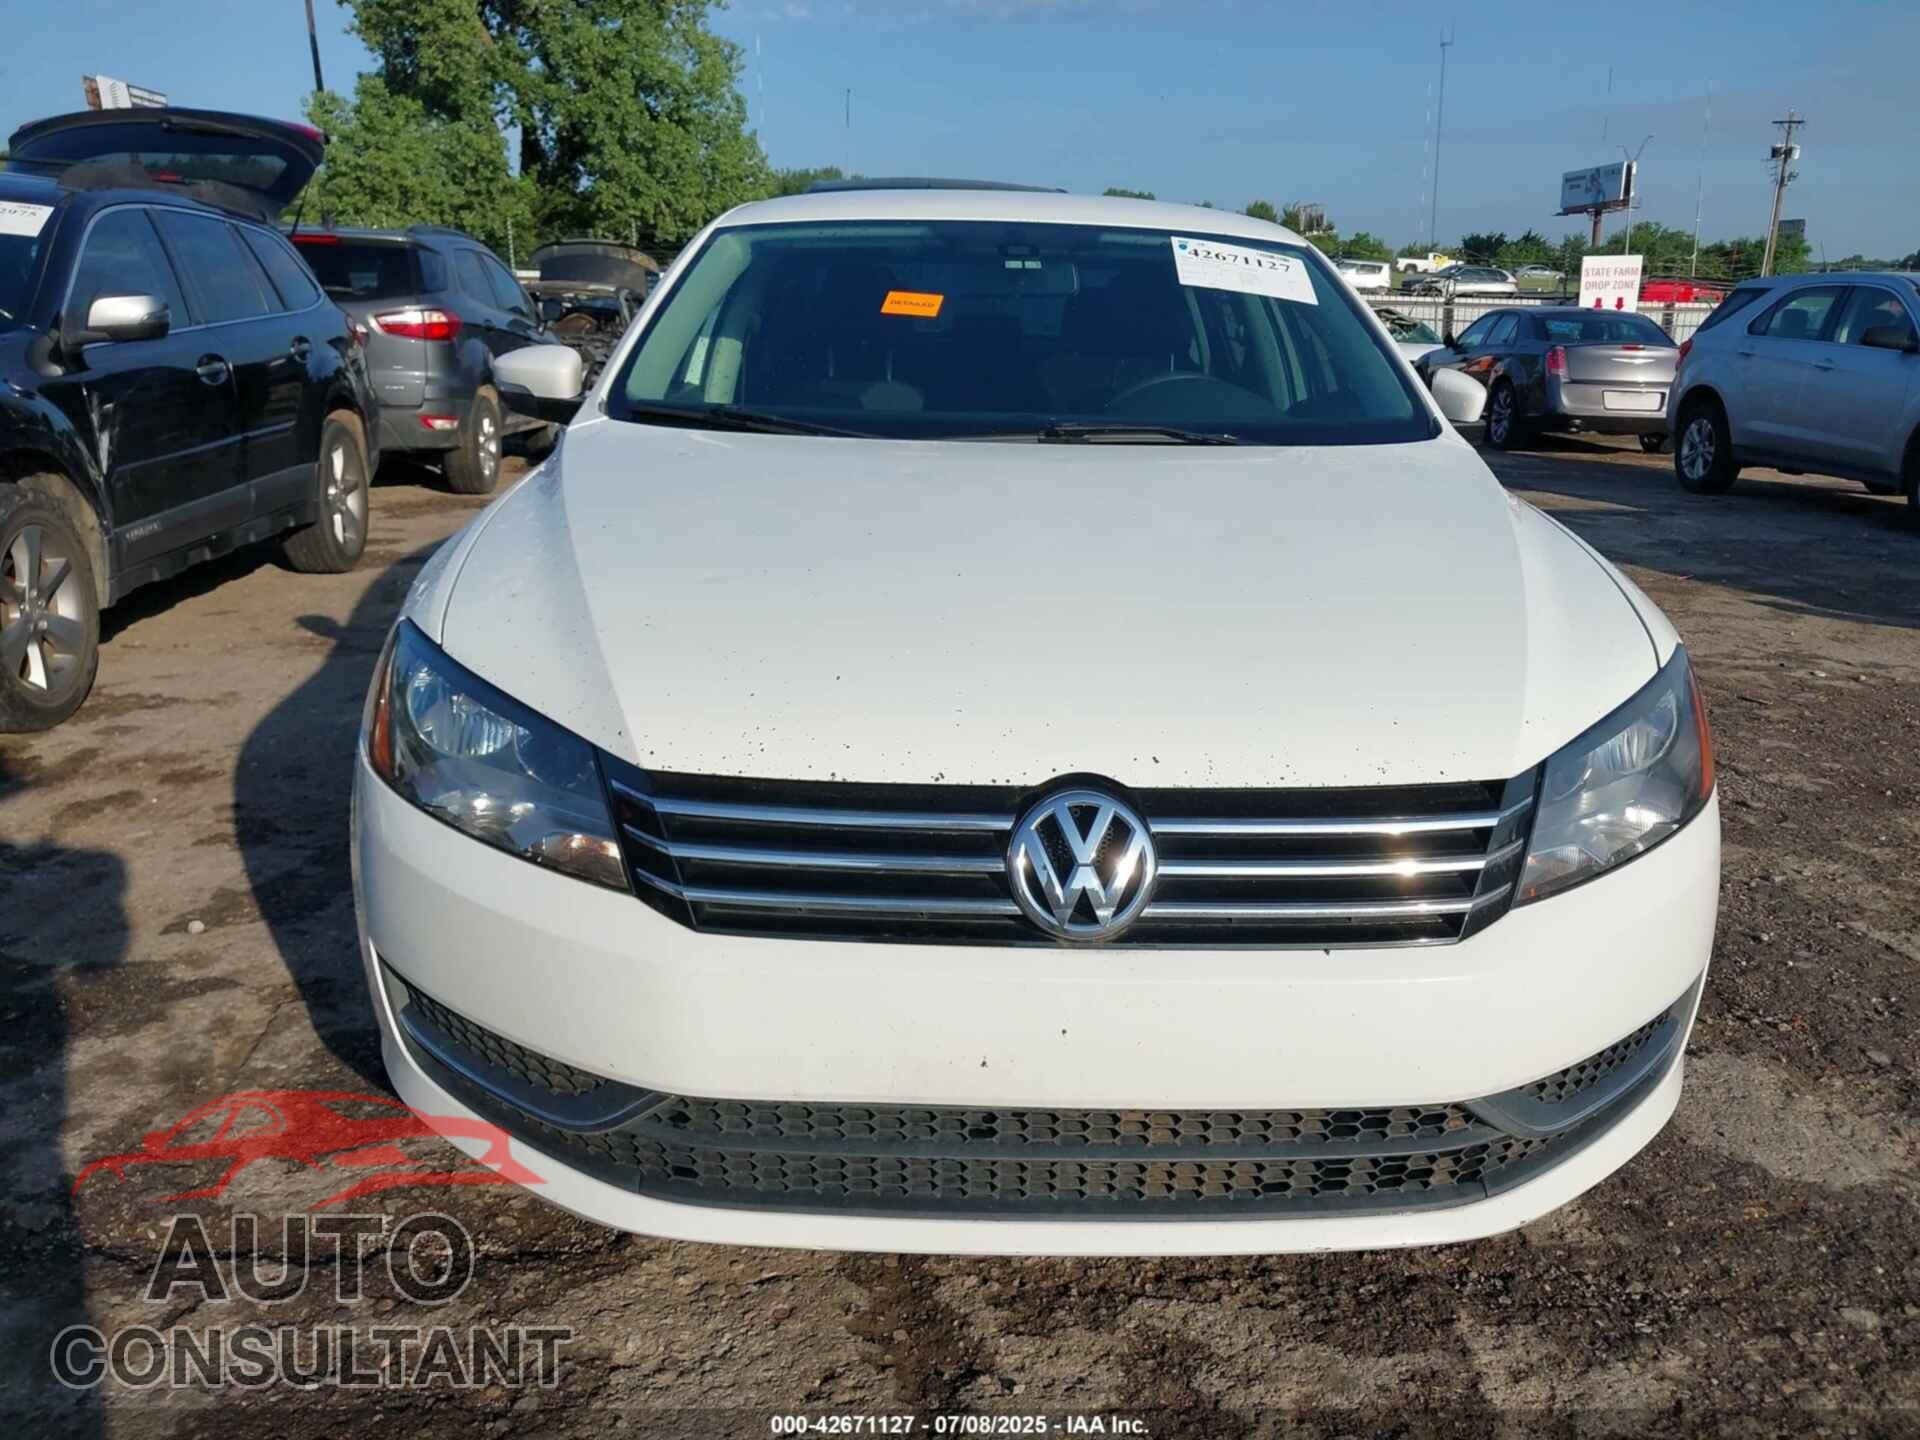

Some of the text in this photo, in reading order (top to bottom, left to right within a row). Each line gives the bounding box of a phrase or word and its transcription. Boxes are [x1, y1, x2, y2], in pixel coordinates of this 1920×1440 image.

[1187, 248, 1290, 273] 42671127
[1584, 266, 1640, 277] STATE FARM
[1584, 280, 1637, 290] DROP ZONE
